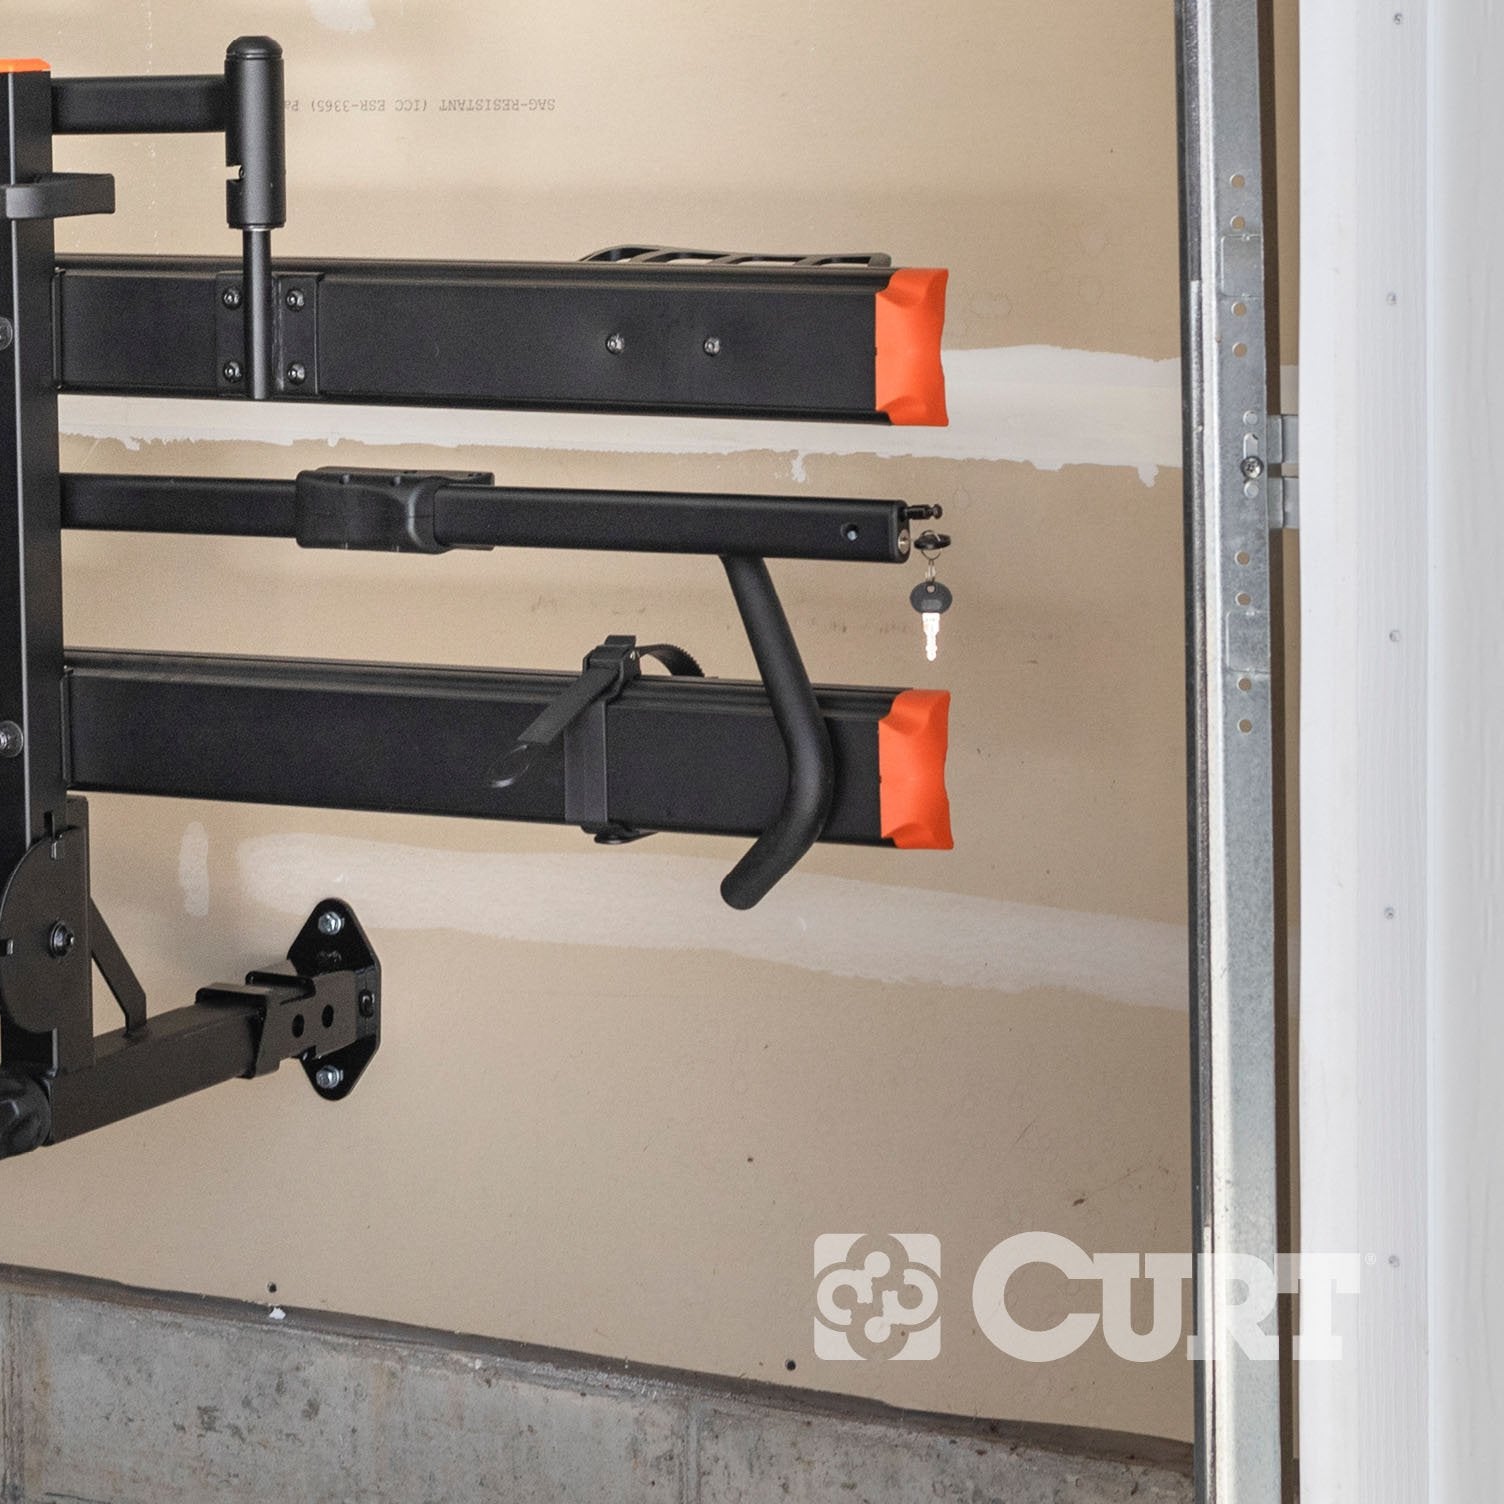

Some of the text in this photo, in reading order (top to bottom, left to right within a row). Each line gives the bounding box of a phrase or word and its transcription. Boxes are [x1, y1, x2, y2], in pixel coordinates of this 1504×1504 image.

[310, 99, 386, 113] ESR-3365)
[394, 99, 427, 113] (ICC
[439, 98, 556, 112] SAG-RESISTANT
